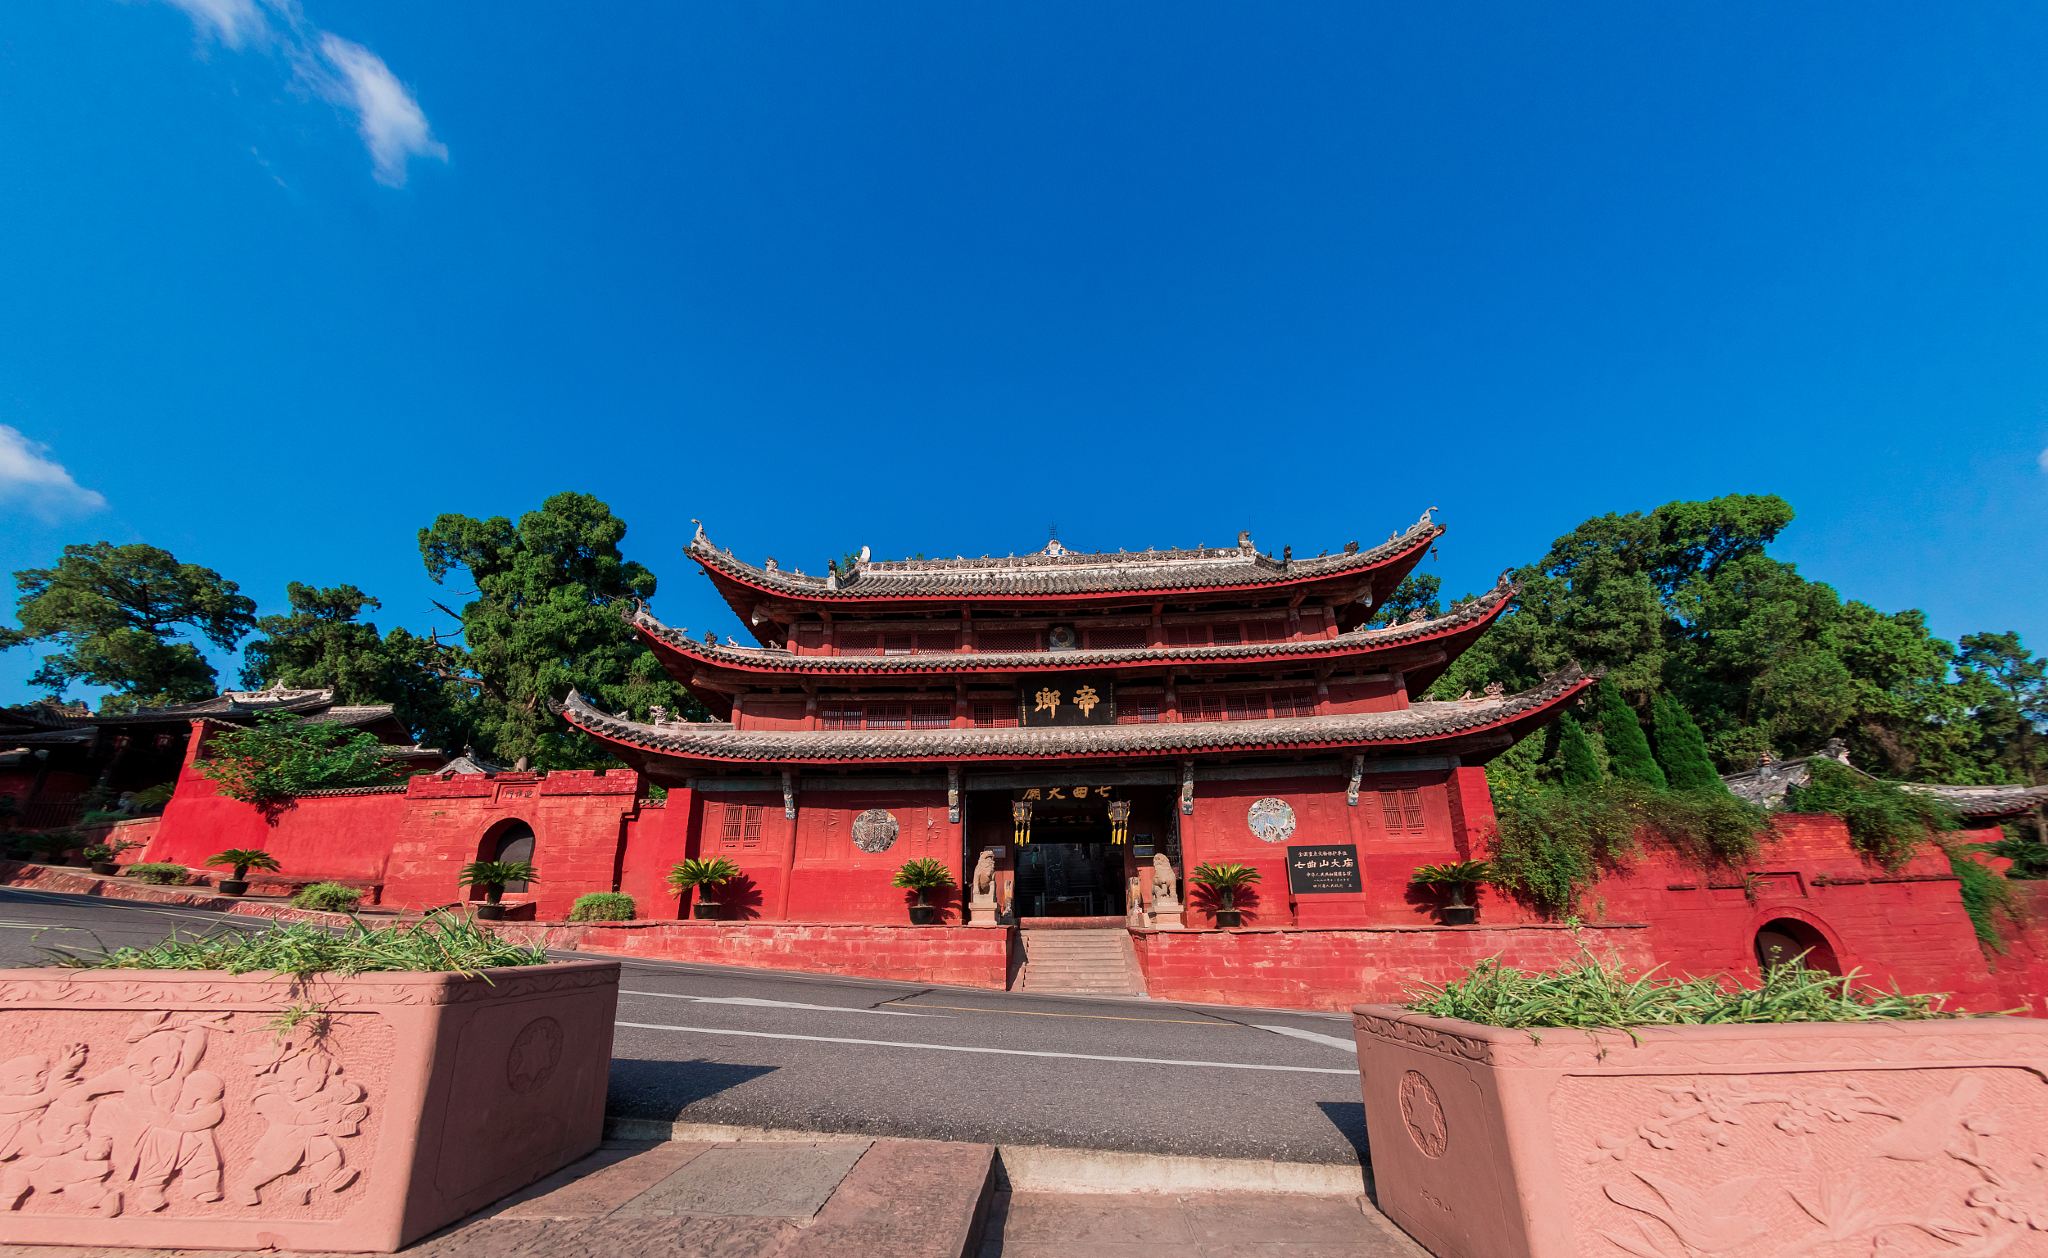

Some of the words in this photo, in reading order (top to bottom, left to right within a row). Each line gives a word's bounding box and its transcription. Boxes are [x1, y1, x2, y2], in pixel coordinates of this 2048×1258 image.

[1294, 858, 1354, 869] 七曲山大庙
